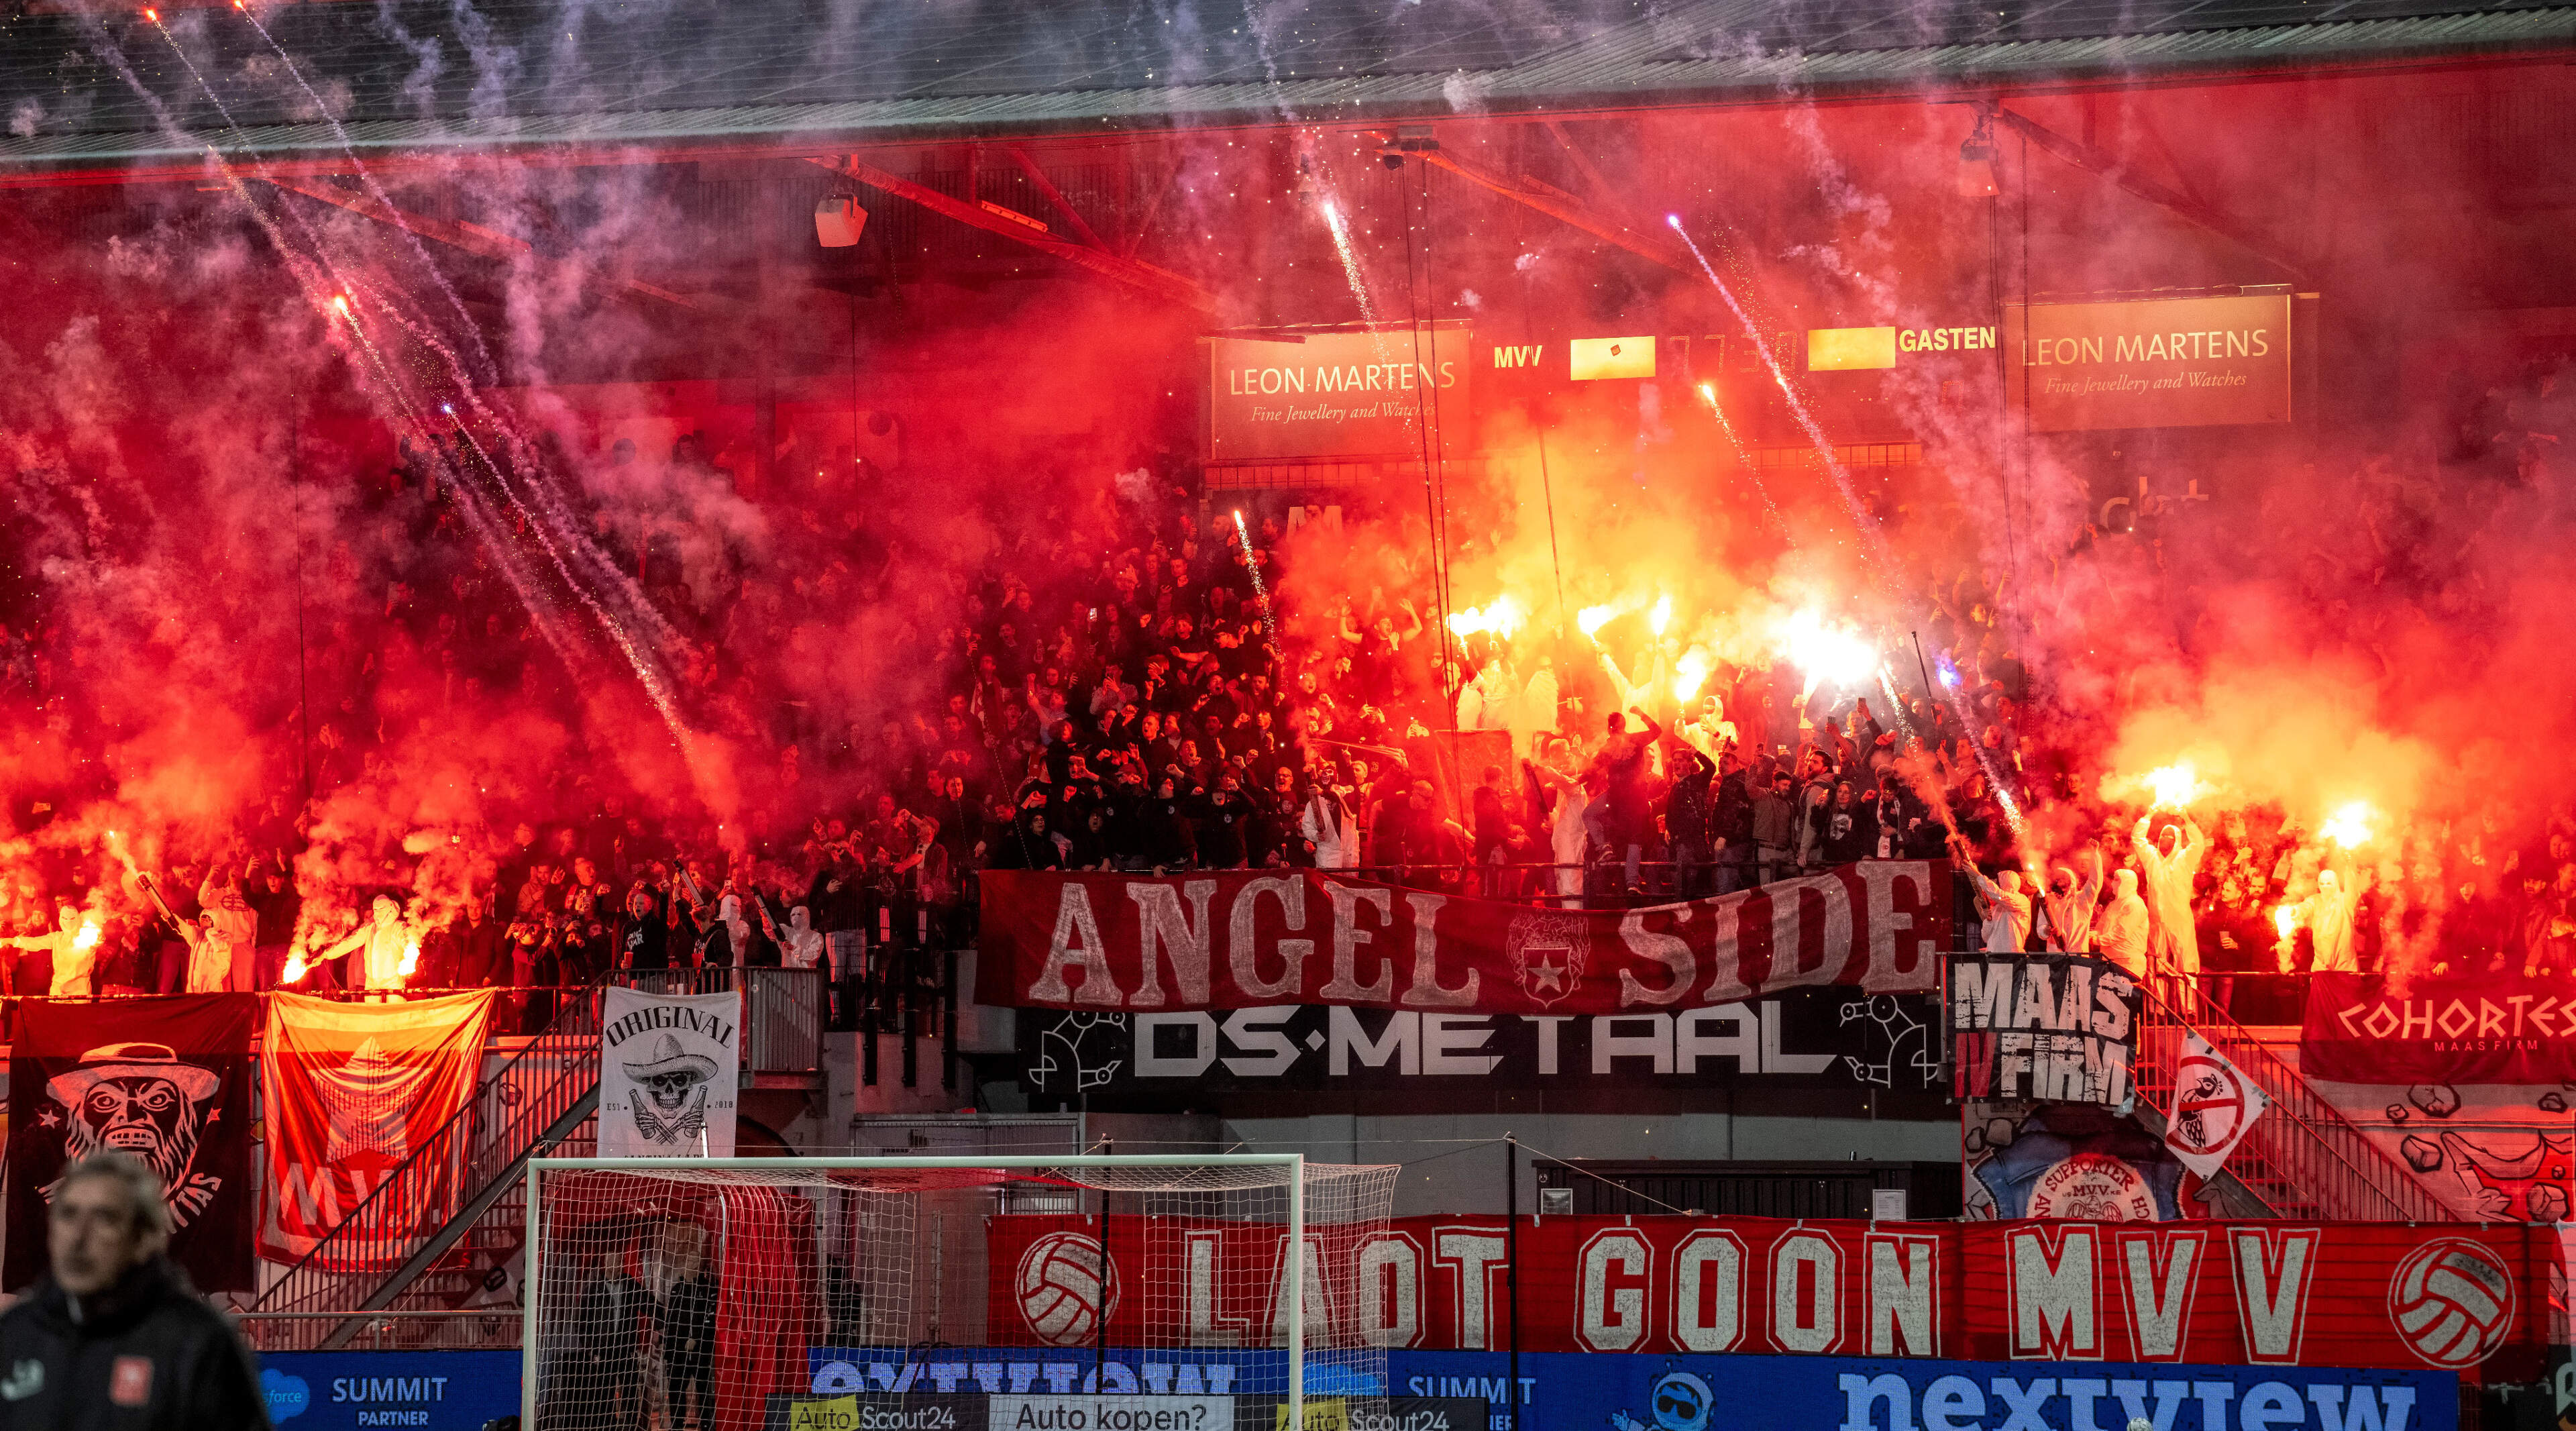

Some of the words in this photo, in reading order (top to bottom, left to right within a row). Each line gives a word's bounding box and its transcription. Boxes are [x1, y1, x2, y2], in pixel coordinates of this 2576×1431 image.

[1898, 326, 1996, 352] GASTEN
[2022, 337, 2103, 366] LEON
[2114, 329, 2269, 363] MARTENS
[1494, 345, 1543, 368] MVV
[1230, 366, 1304, 395] LEON
[1315, 362, 1456, 392] MARTENS
[2045, 377, 2078, 393] Fine
[2080, 374, 2149, 396] Jewellery
[2153, 372, 2184, 390] and
[2188, 370, 2247, 387] Watches
[1252, 406, 1282, 421] Fine
[1283, 404, 1346, 424] Jewellery
[1350, 402, 1378, 418] and
[1382, 401, 1436, 417] Watches
[1028, 874, 1480, 1006] ANGEL
[1618, 860, 1937, 1007] SIDE
[1954, 963, 2134, 1040] MAAS
[606, 1006, 736, 1049] ORIGINAL
[2434, 1041, 2485, 1051] MAAS
[2494, 1040, 2538, 1051] FIRM
[2000, 1032, 2128, 1106] FIRM
[2045, 1157, 2135, 1192] SUPPORTER
[1183, 1226, 1511, 1352] LAOT
[1573, 1227, 1941, 1357] GOON
[2004, 1224, 2322, 1365] MVV
[267, 1389, 302, 1408] force
[332, 1377, 449, 1402] SUMMIT
[1409, 1376, 1537, 1404] SUMMT
[358, 1410, 430, 1427] PARTNER
[1016, 1403, 1087, 1430] Auto
[1097, 1403, 1208, 1431] kopen?
